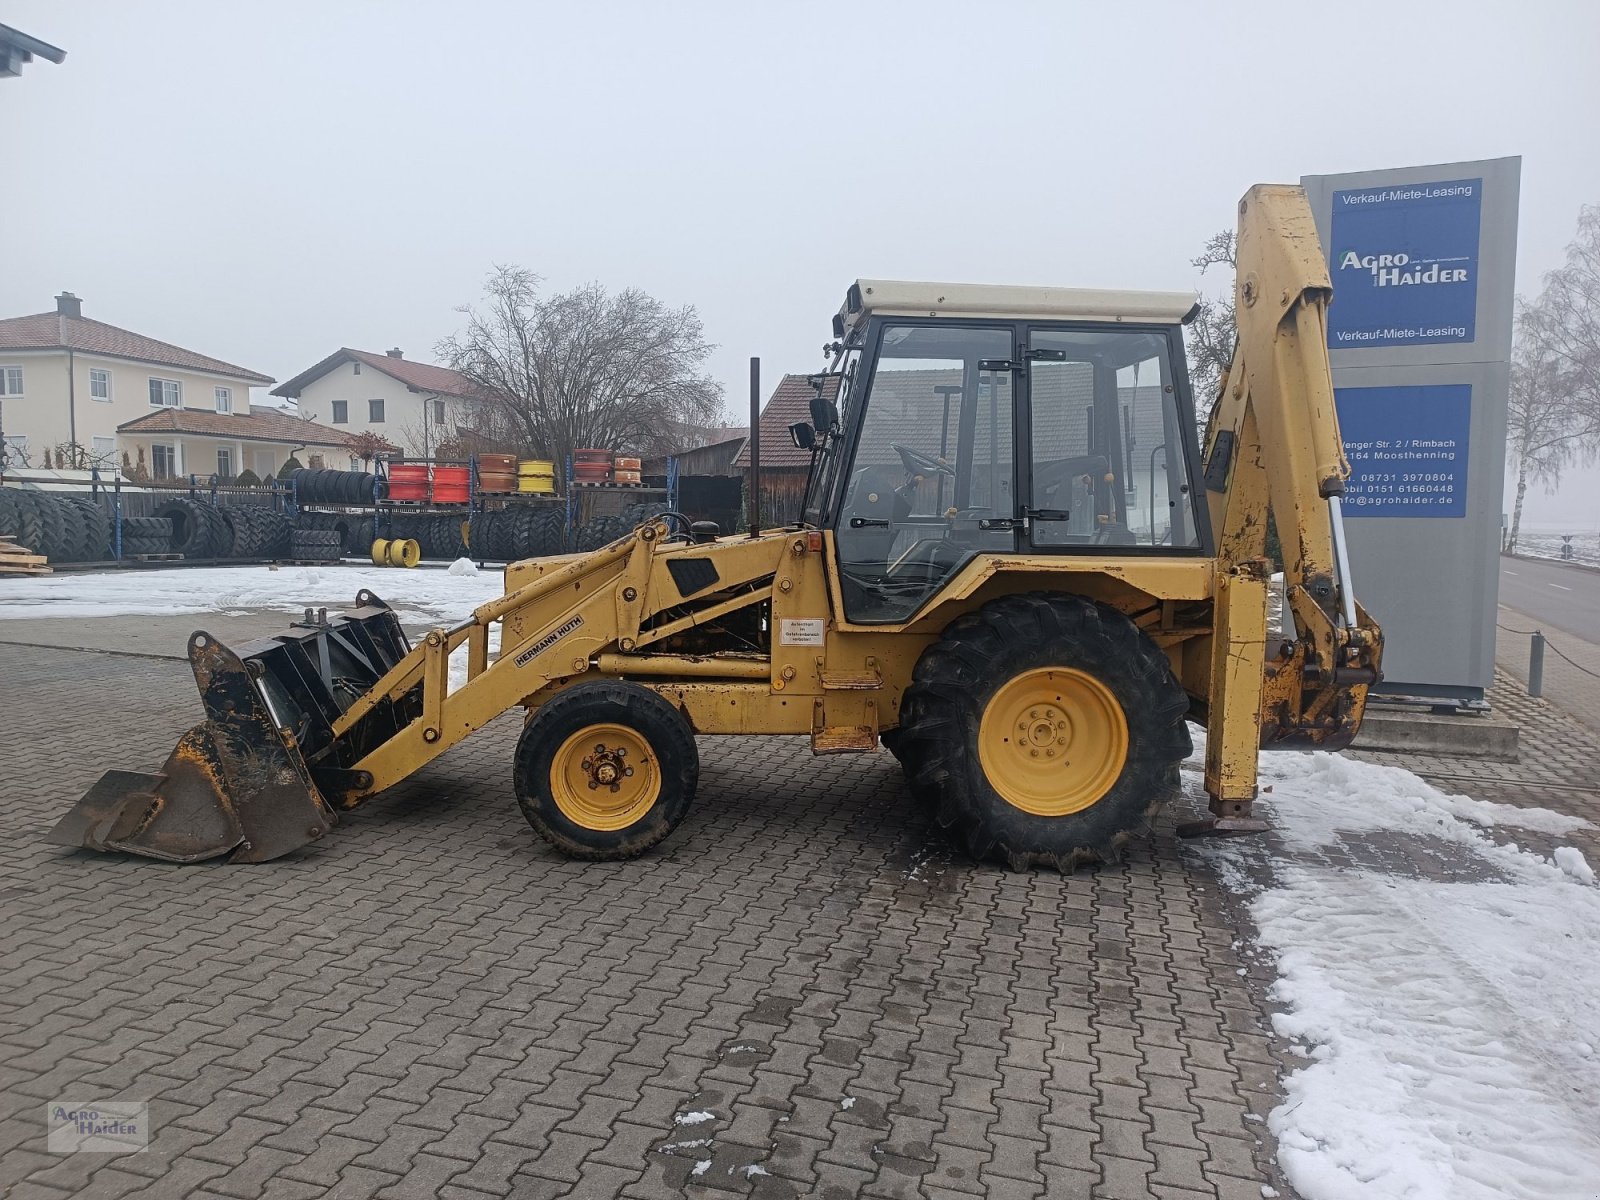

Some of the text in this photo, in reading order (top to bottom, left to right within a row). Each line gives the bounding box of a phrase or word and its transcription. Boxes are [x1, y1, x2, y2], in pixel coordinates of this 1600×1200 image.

[1342, 185, 1473, 205] Verkauf-Miete-Leasing
[1336, 326, 1466, 341] Verkauf-Miete-Leasing
[1343, 441, 1373, 450] enger
[1376, 440, 1392, 448] Str.
[1395, 440, 1402, 448] 2
[1412, 440, 1456, 448] Rimbach
[1374, 452, 1455, 460] Moosthenning
[1361, 474, 1396, 482] 08731
[1403, 473, 1454, 482] 3970804
[1344, 485, 1454, 493] obil 0151 61660448
[1340, 496, 1453, 505] nfo@agrohaider.de
[516, 616, 582, 665] HERMANN HUTH
